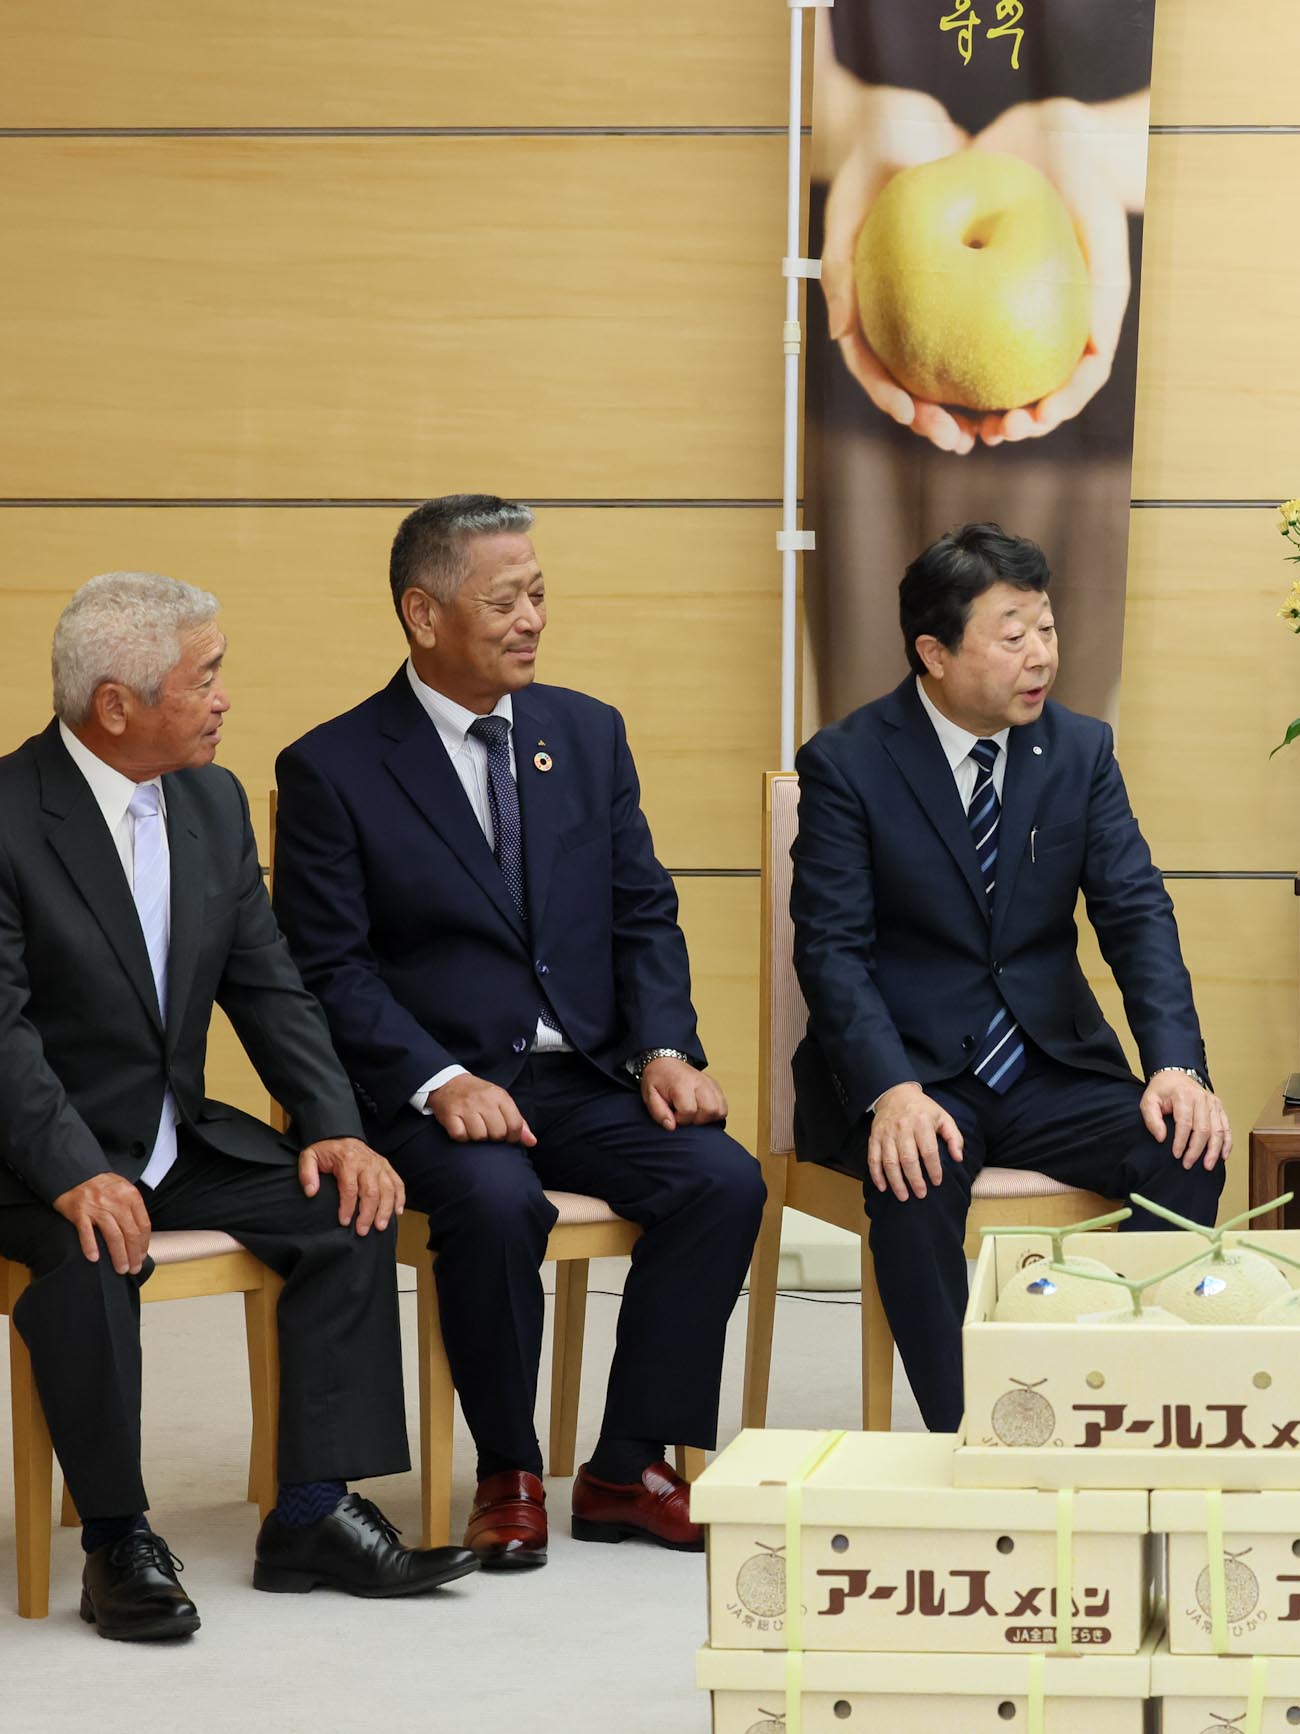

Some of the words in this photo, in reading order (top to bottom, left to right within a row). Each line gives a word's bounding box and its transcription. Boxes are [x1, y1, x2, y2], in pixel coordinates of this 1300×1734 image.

[1012, 1627, 1104, 1643] JA全農ばらき
